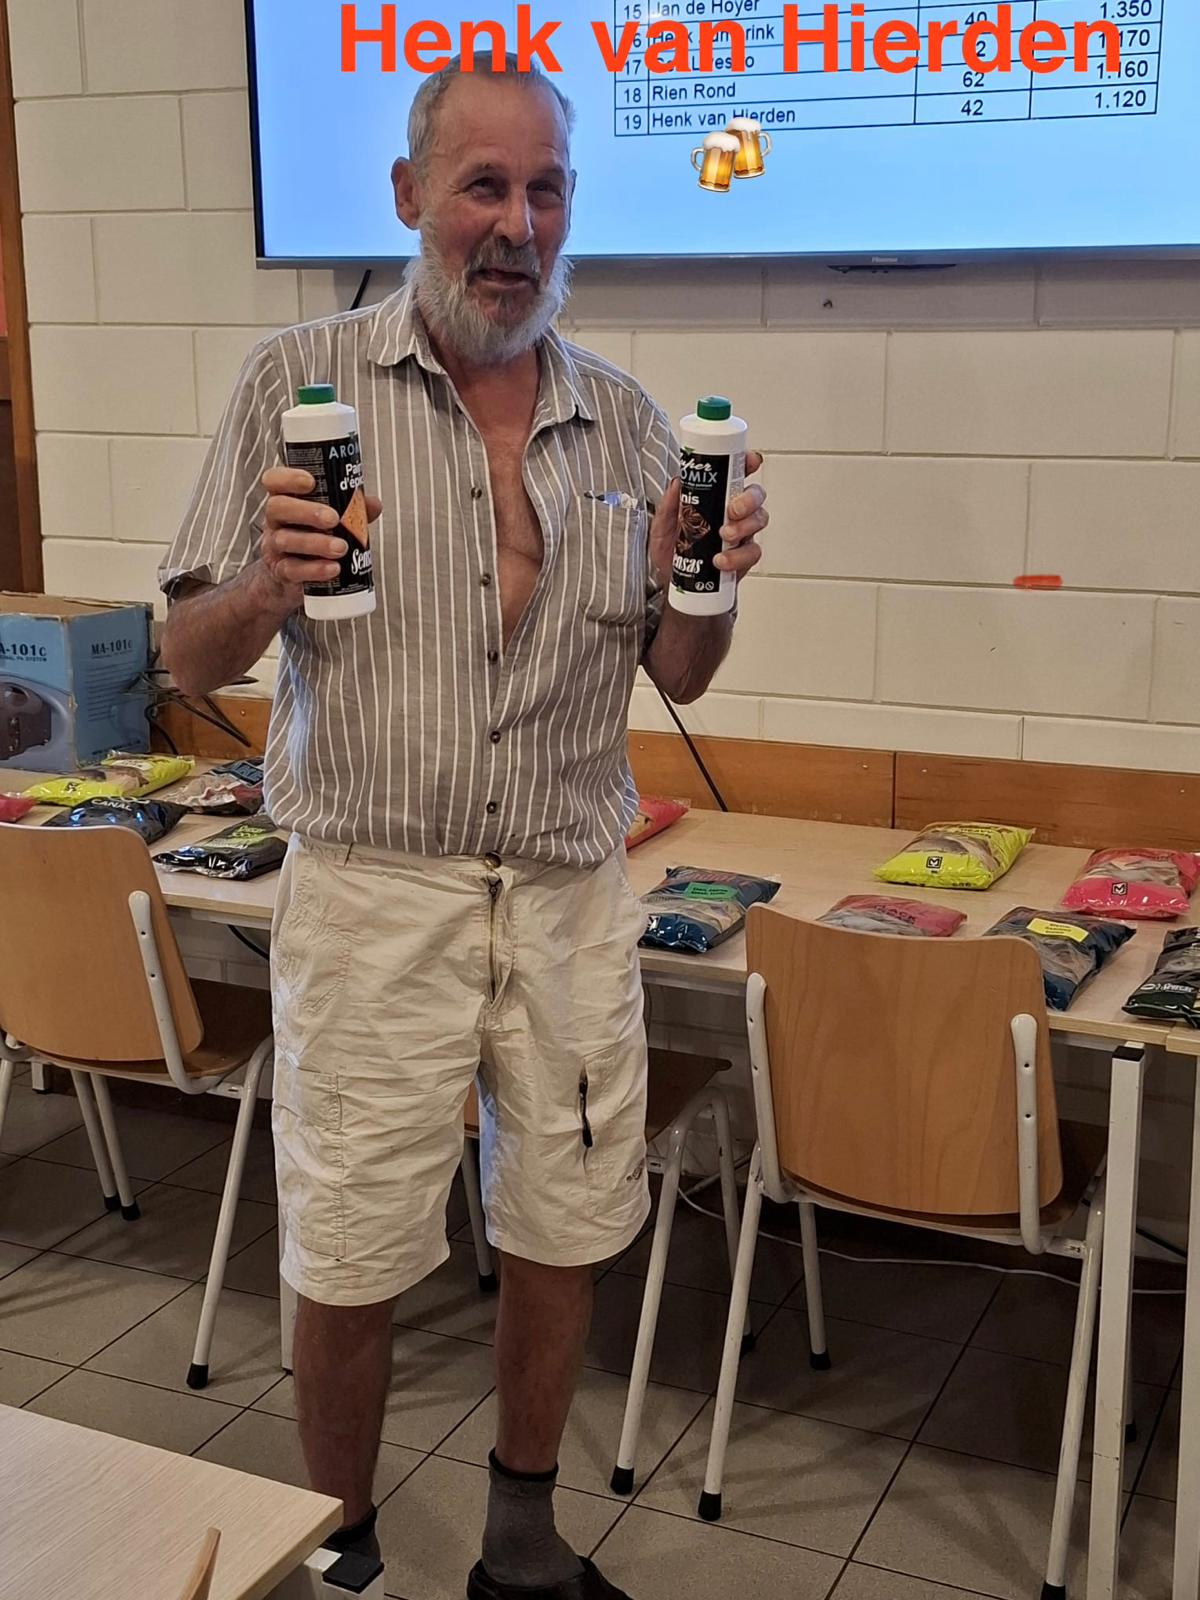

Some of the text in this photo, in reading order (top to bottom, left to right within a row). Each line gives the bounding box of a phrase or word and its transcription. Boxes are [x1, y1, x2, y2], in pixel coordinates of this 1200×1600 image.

[624, 5, 642, 19] 15
[686, 0, 705, 15] de
[712, 0, 760, 17] Hoyer
[1100, 0, 1153, 19] 1.350
[624, 88, 642, 103] 18
[652, 85, 688, 101] Rien
[694, 83, 736, 99] Rond
[962, 71, 985, 87] 62
[624, 115, 642, 130] 19
[652, 111, 692, 128] Henk
[698, 112, 726, 127] van
[961, 99, 984, 116] 42
[1095, 90, 1147, 108] 1.120
